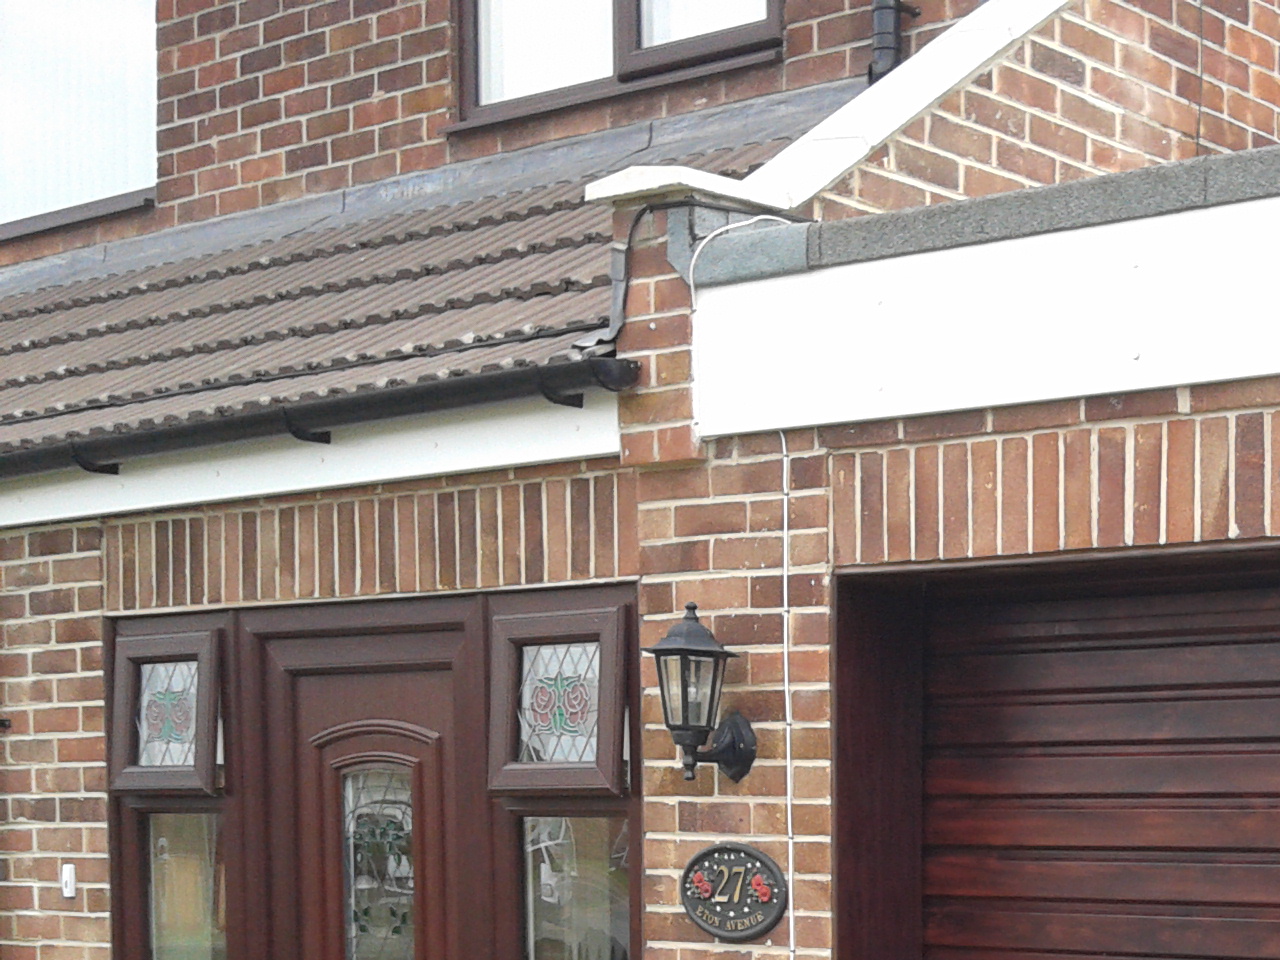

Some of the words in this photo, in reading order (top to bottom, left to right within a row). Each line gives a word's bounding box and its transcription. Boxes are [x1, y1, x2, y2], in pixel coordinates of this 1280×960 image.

[714, 865, 746, 903] 27
[695, 905, 721, 927] ETON
[725, 911, 764, 930] AVENUE
